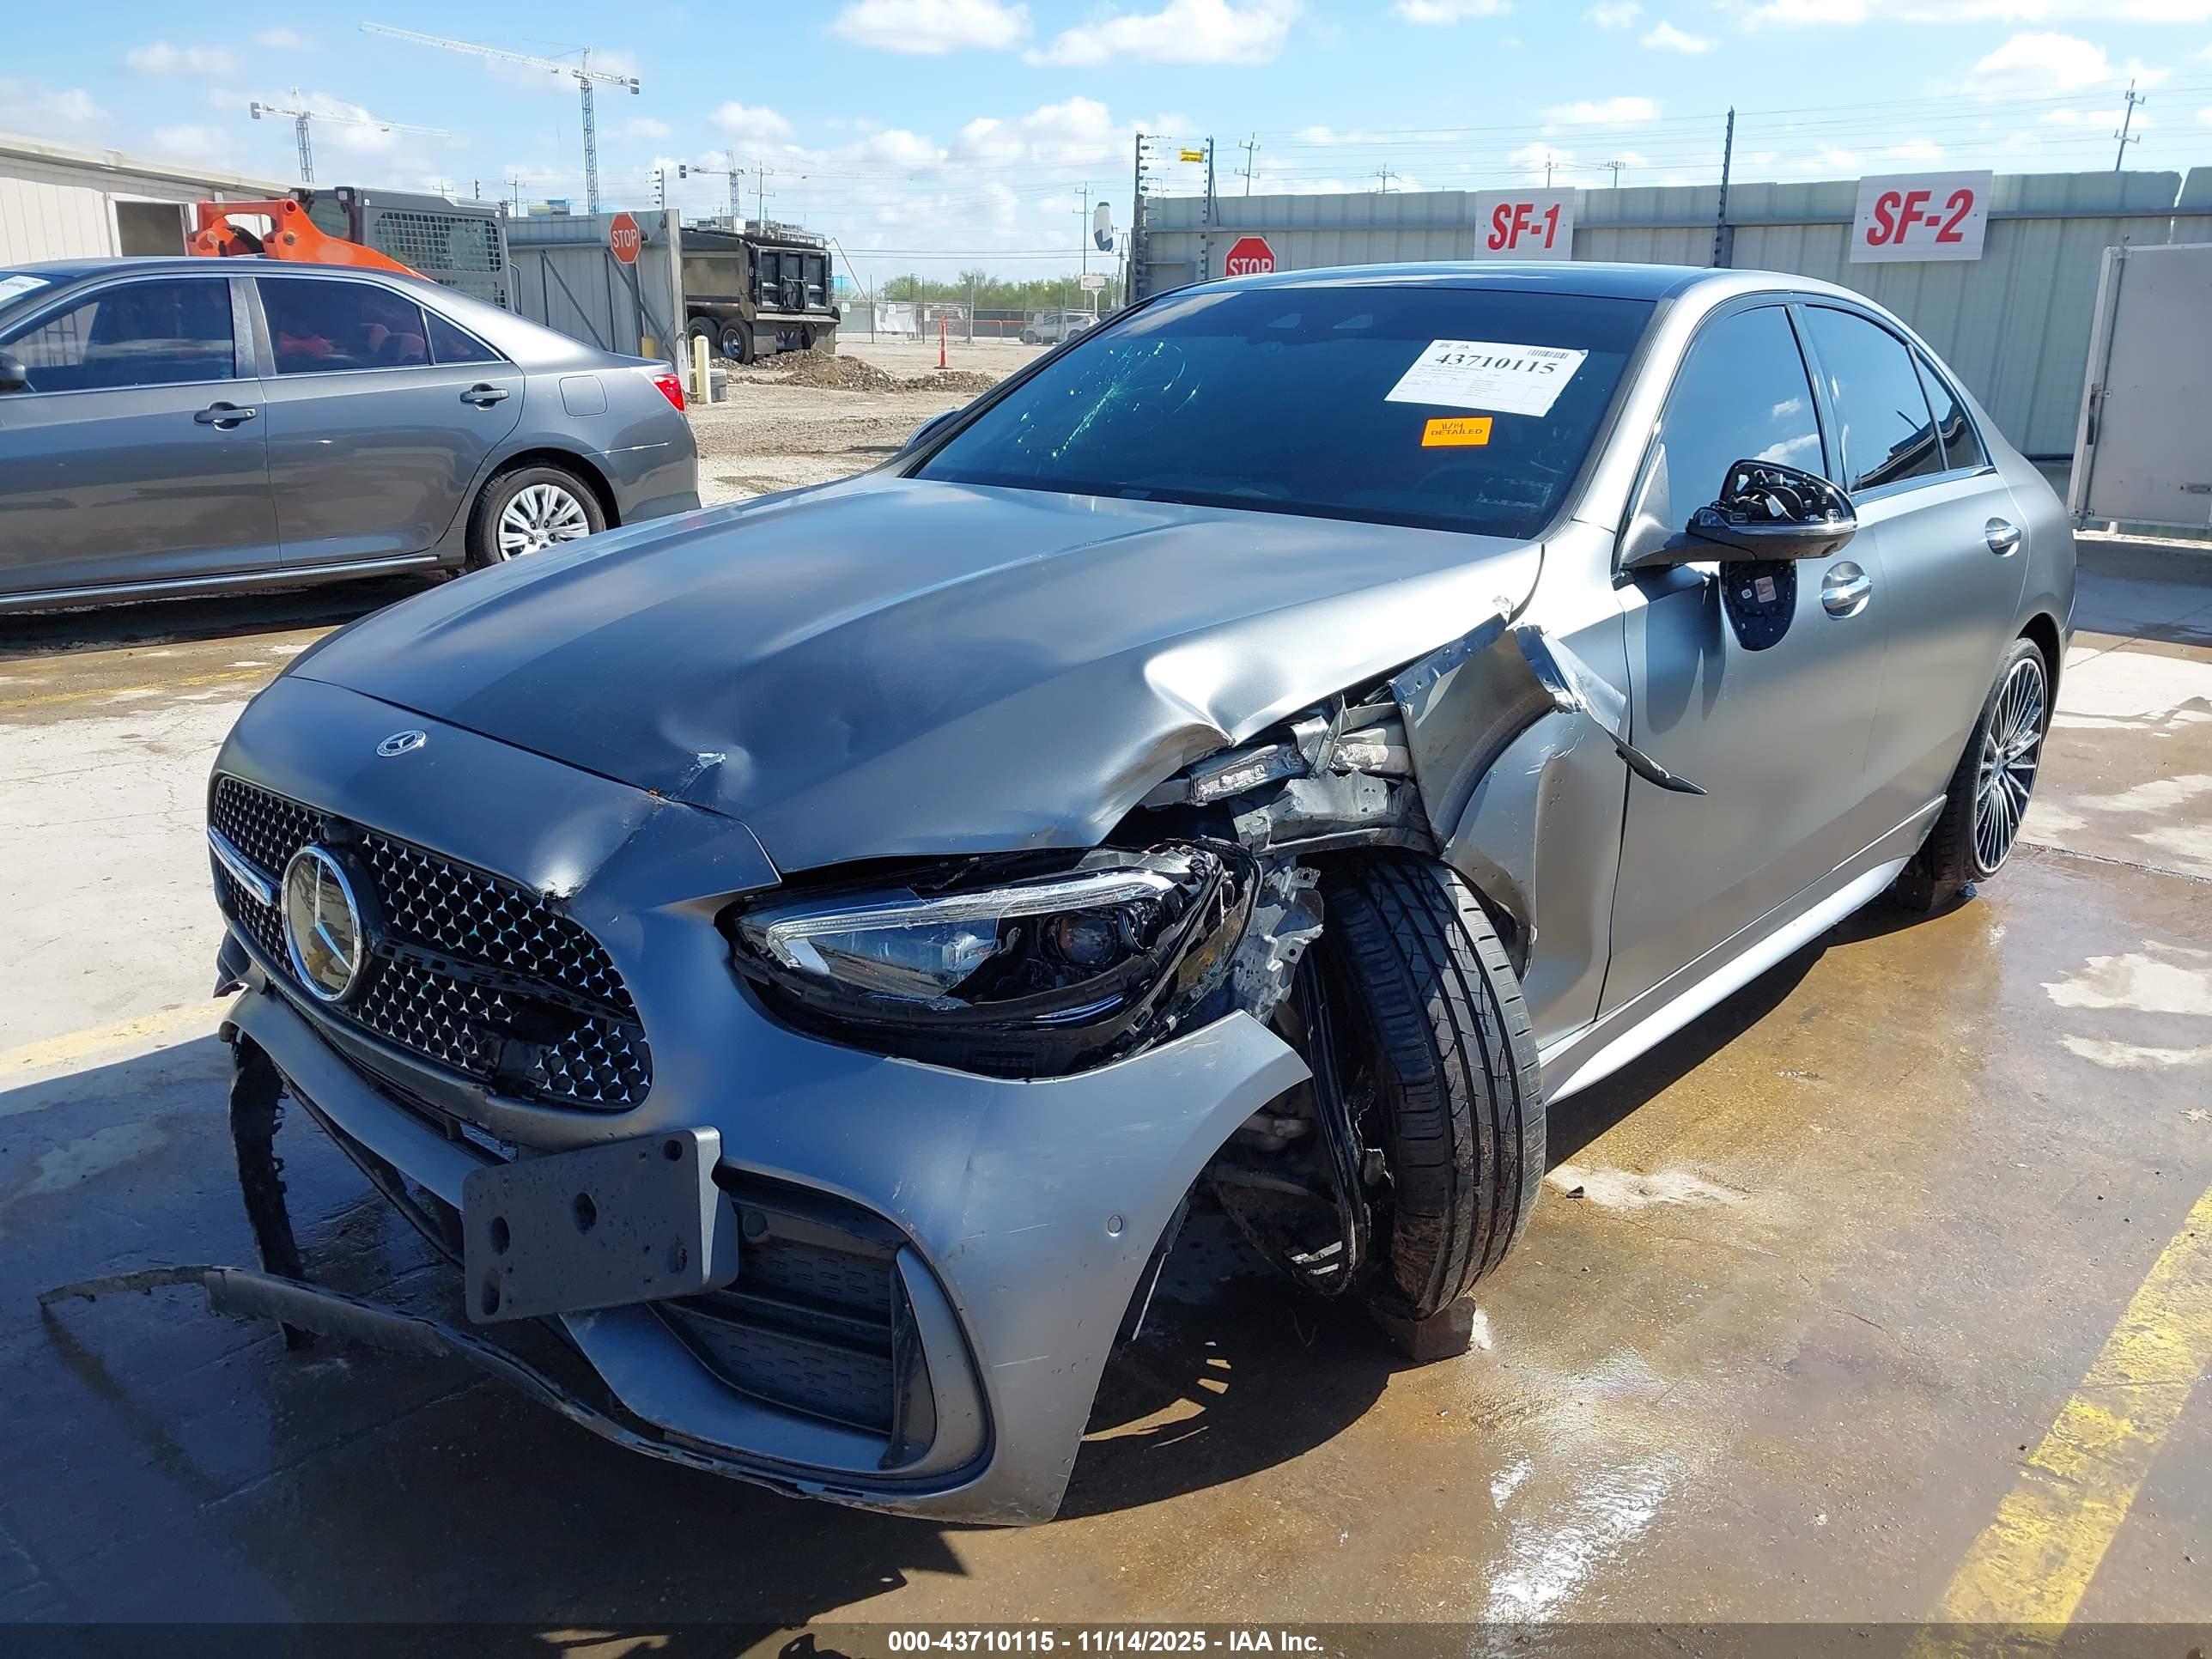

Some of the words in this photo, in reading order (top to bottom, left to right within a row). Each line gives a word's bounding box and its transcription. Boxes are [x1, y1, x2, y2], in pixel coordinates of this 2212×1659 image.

[1486, 202, 1561, 251] SF-1
[1866, 188, 1974, 246] SF-2
[612, 228, 637, 248] STOP
[1229, 258, 1273, 276] STOP
[1434, 353, 1559, 375] 43710115
